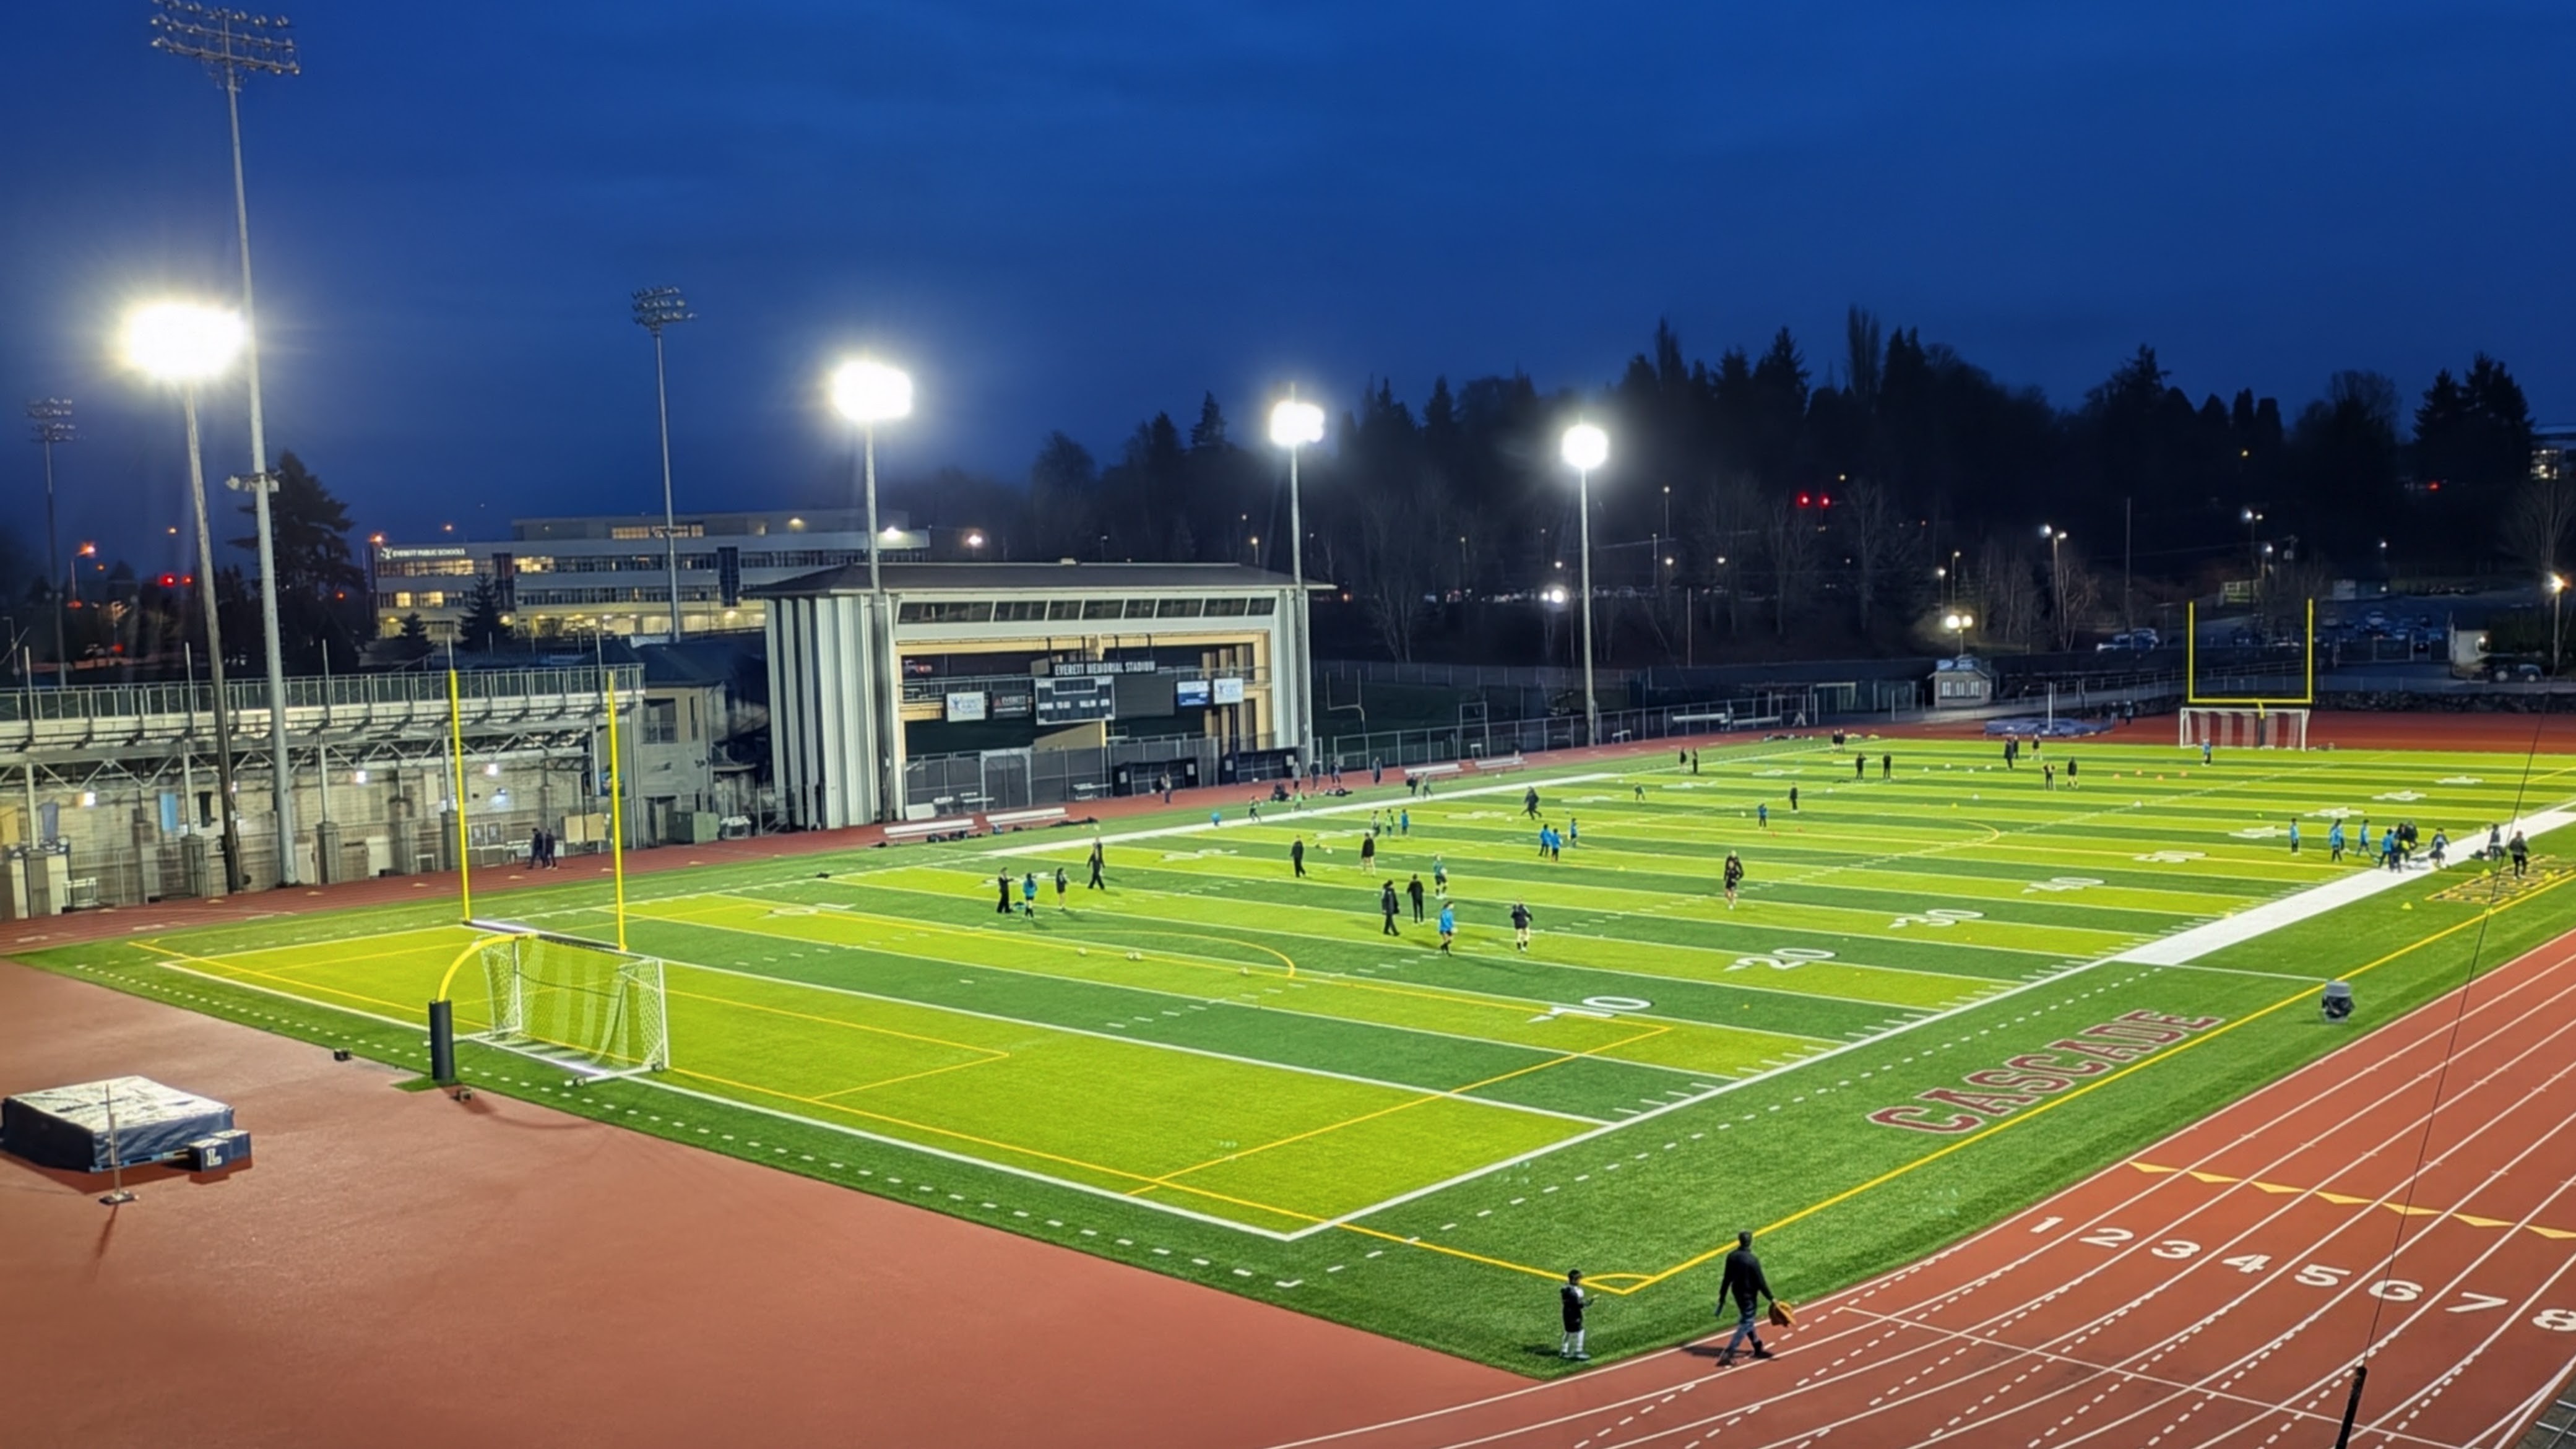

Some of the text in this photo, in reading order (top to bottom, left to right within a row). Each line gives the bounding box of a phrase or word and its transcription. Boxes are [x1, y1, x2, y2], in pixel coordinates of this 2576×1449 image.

[1055, 660, 1156, 676] EVERETT MEMORIAL STADIUM
[1894, 909, 1984, 927] 30
[1735, 948, 1836, 970] 20
[1547, 995, 1653, 1019] 10
[1866, 1009, 2226, 1134] CASCADE
[206, 1148, 222, 1167] L
[2029, 1216, 2576, 1331] 1 2 3 4 5 6 7 8
